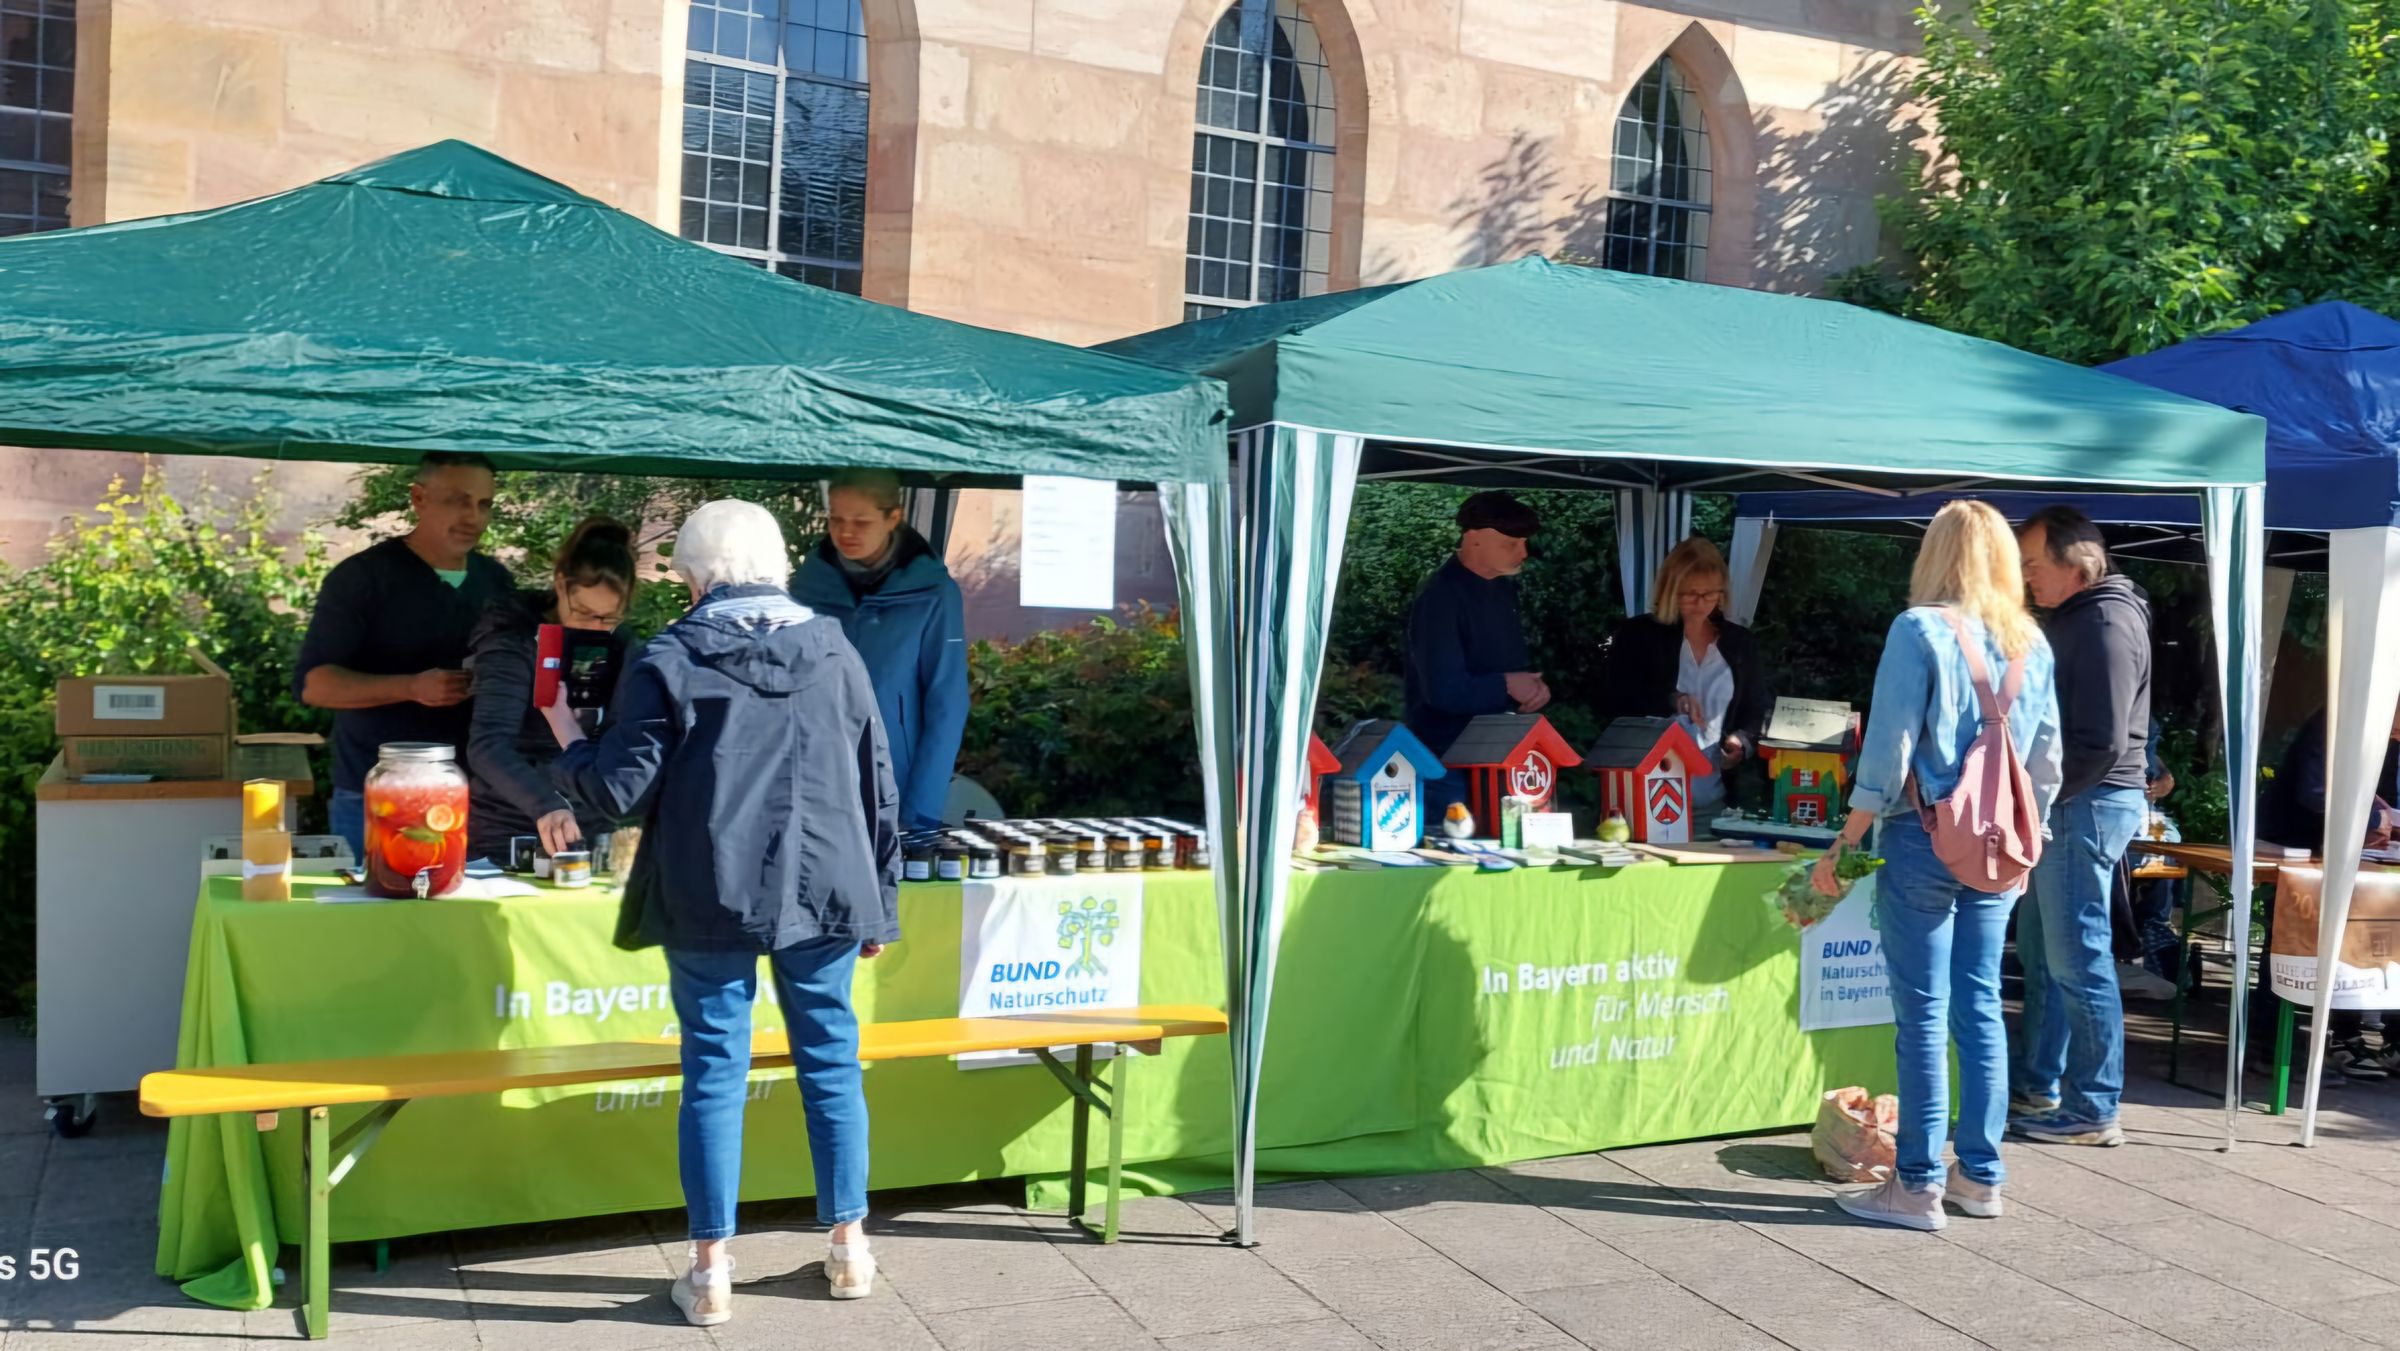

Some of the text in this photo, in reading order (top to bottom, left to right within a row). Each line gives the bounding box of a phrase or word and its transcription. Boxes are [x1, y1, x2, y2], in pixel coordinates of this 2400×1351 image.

[1822, 940, 1872, 959] BUND
[990, 961, 1061, 983] BUND
[1483, 951, 1680, 998] In Bayern aktiv
[1821, 961, 1888, 981] Natursch
[495, 983, 531, 1019] In
[989, 987, 1109, 1010] Naturschutz
[1592, 986, 1730, 1027] für Mensch
[1820, 986, 1834, 1001] in
[1838, 986, 1882, 1003] Bayern
[1551, 1034, 1677, 1069] und Natur
[595, 1077, 667, 1113] und
